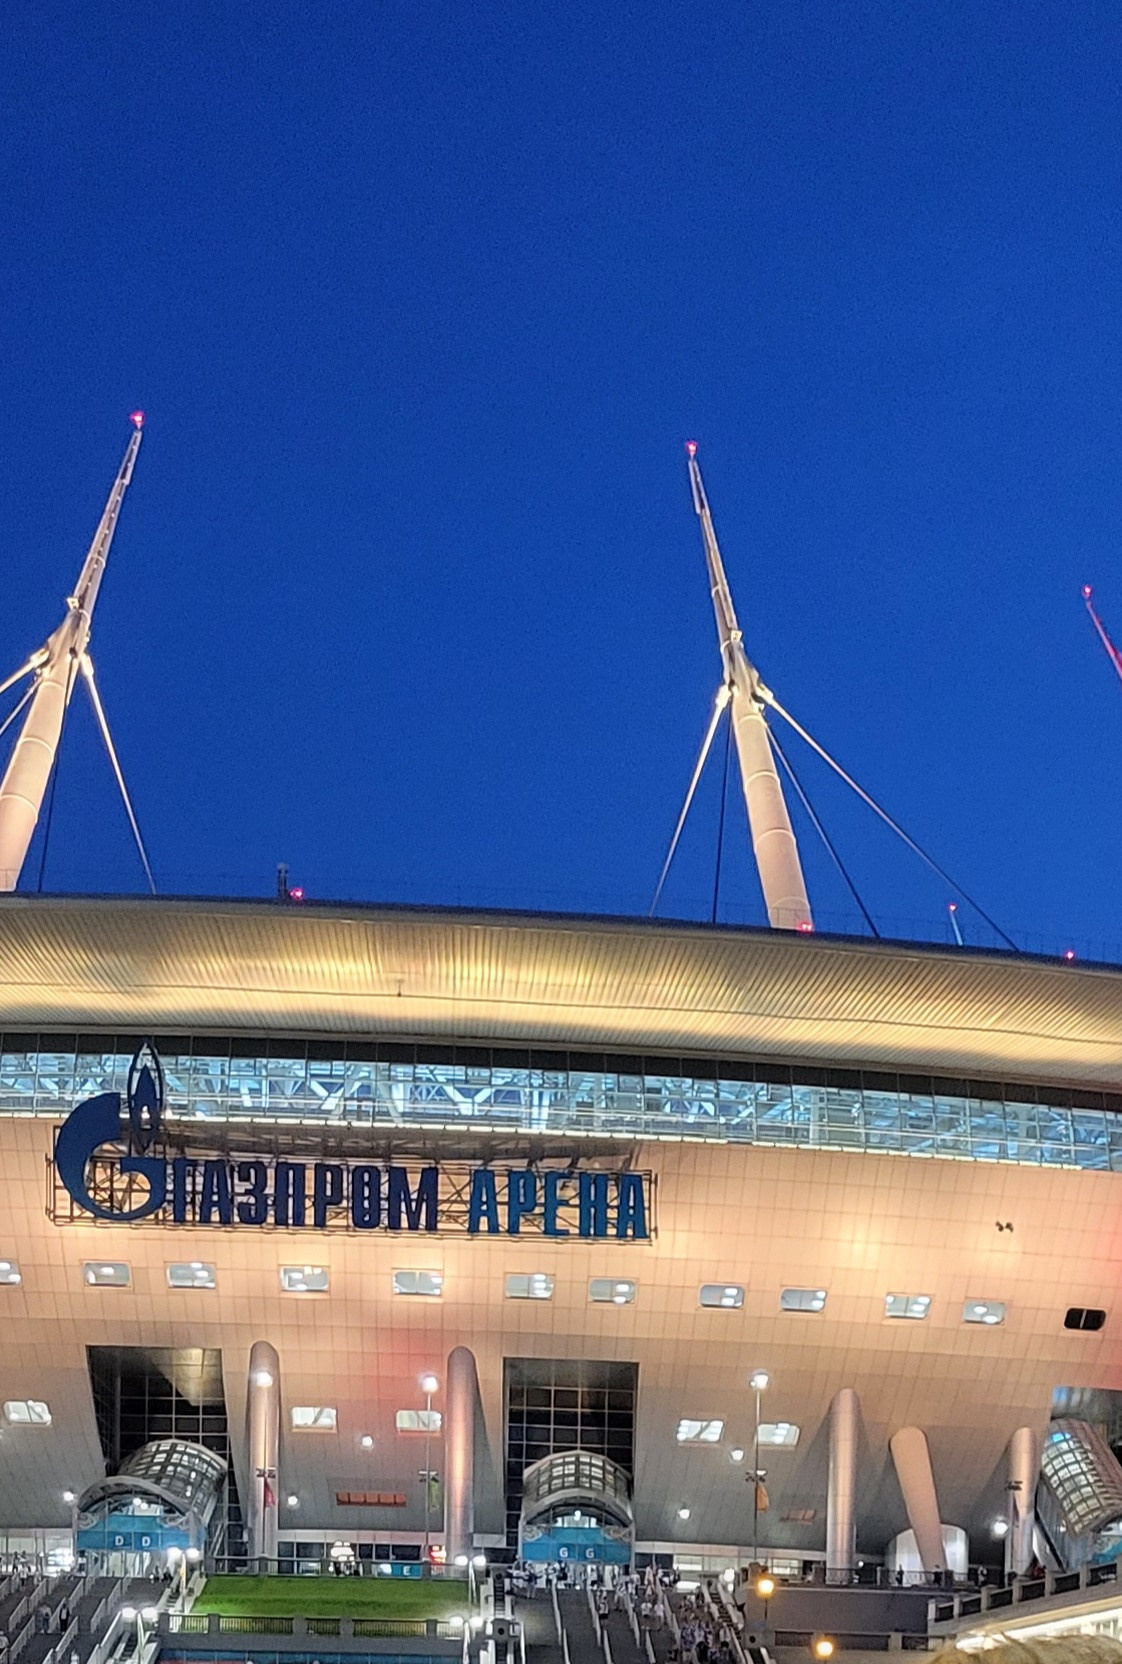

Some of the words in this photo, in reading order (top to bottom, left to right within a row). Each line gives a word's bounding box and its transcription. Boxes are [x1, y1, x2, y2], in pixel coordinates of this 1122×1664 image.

[172, 1158, 438, 1231] ГАЗПРОМ
[468, 1169, 648, 1239] АРЕНА
[115, 1535, 124, 1546] D
[141, 1536, 151, 1547] D
